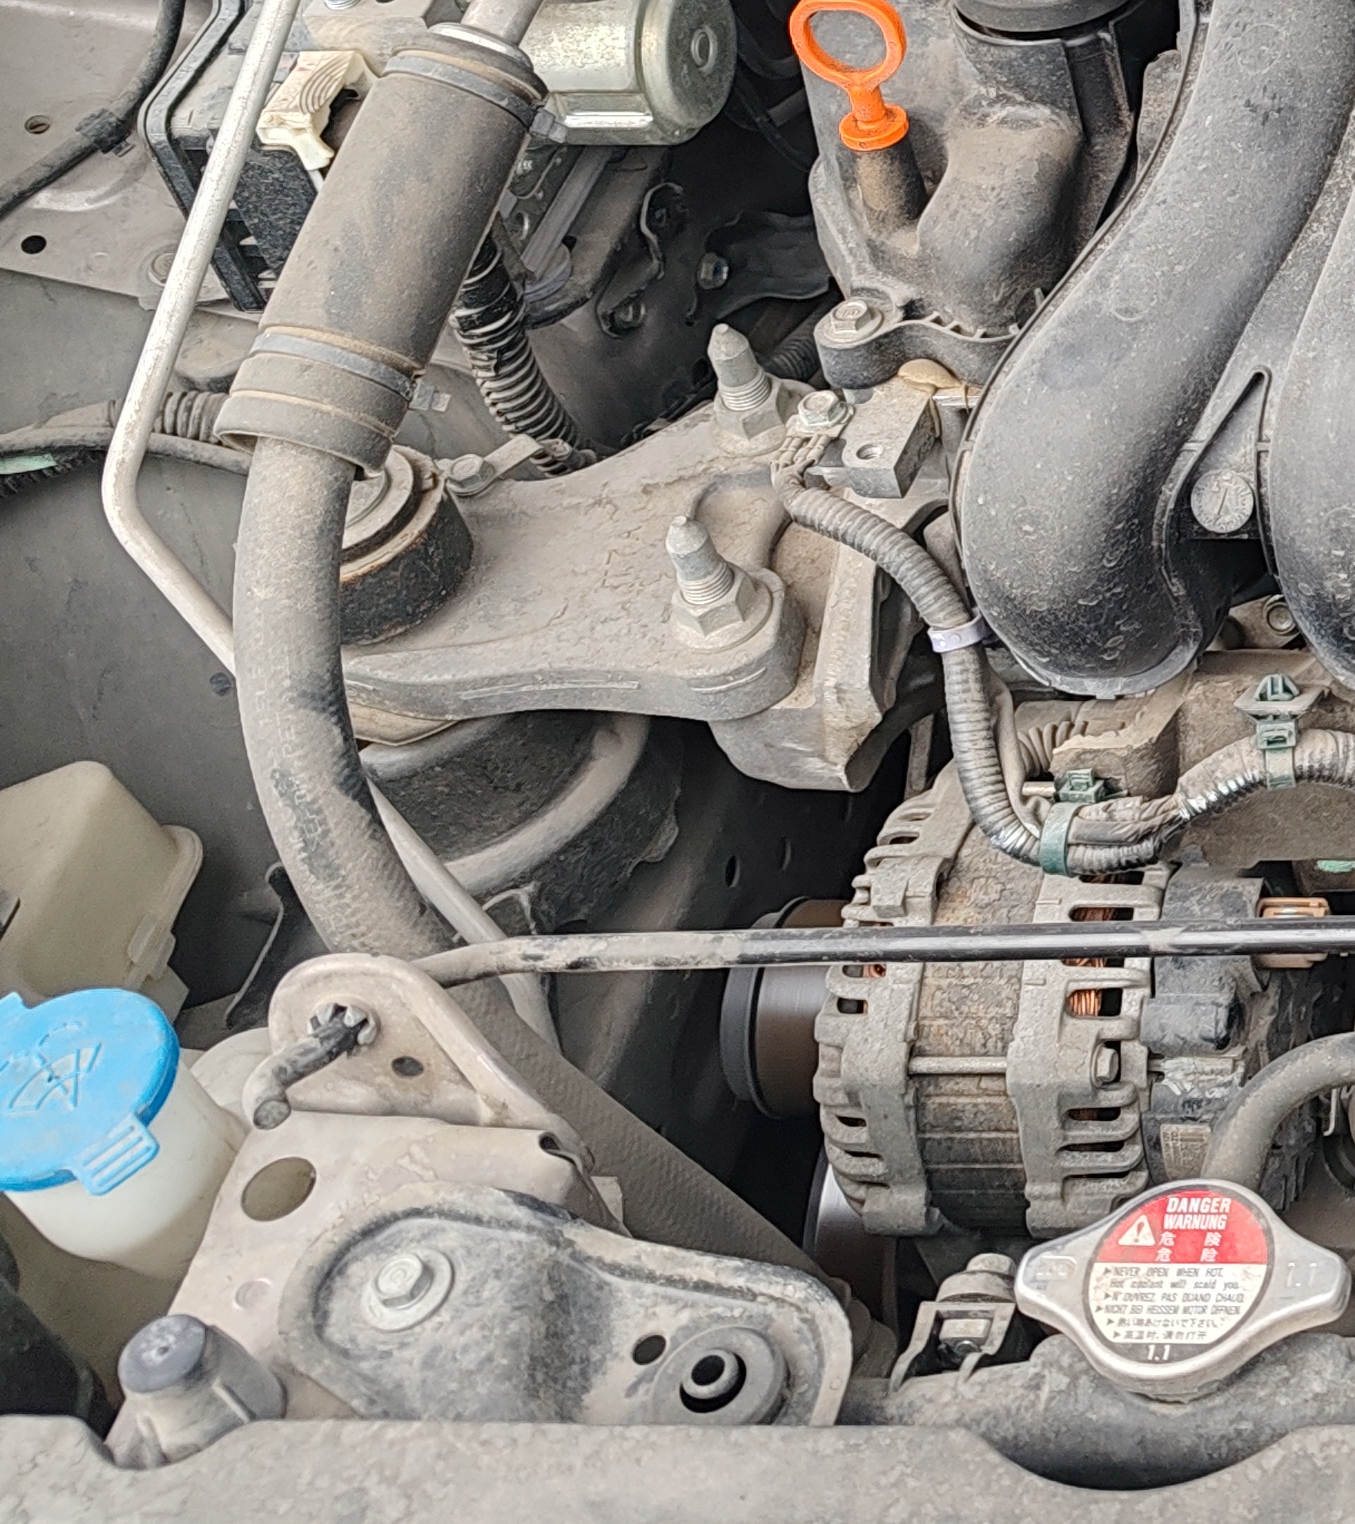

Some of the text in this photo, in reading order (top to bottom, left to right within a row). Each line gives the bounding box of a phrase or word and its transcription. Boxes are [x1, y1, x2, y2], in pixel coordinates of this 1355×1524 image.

[1166, 1197, 1232, 1214] DANGER
[1163, 1214, 1228, 1230] WARNUNG
[1113, 1266, 1141, 1277] NEVER
[1146, 1267, 1169, 1277] OPEN
[1176, 1267, 1200, 1277] WHEN
[1130, 1279, 1163, 1289] coolant
[1193, 1279, 1217, 1289] scald
[1160, 1293, 1178, 1302] PAS
[1146, 1345, 1171, 1361] 1.1
